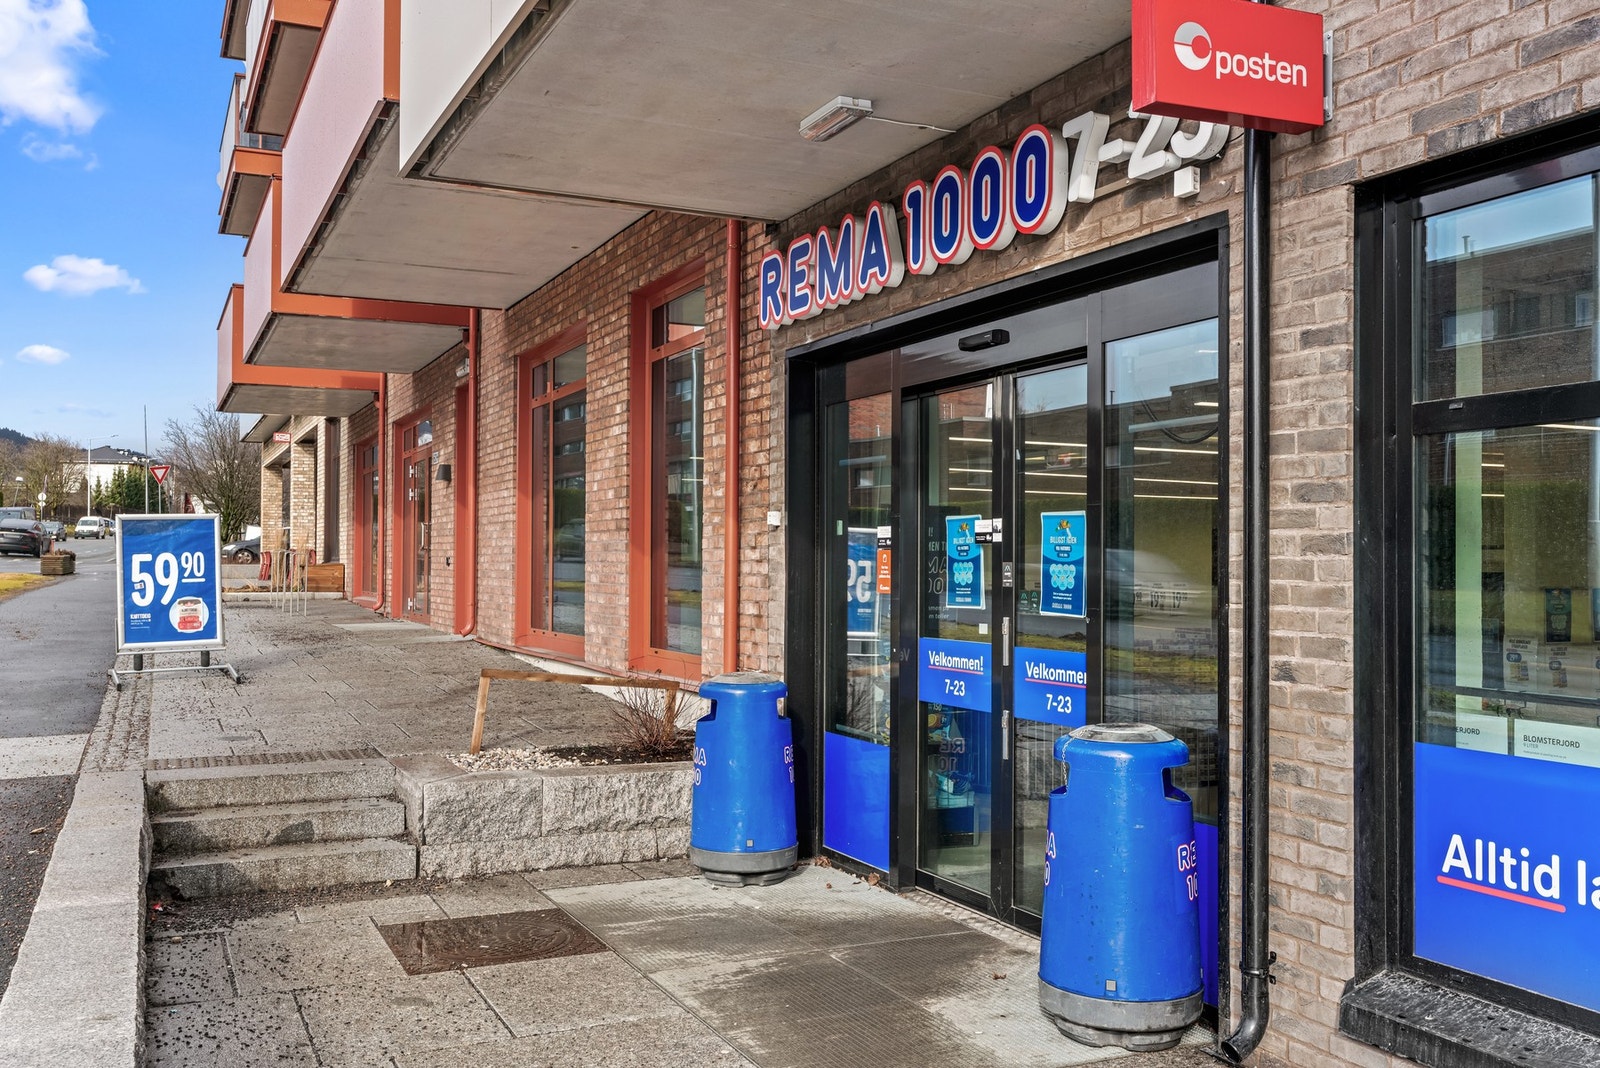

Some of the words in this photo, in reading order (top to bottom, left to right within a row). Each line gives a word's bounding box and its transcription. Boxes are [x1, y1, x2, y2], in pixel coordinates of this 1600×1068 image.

[1216, 51, 1307, 87] posten
[758, 200, 892, 330] REMA
[902, 124, 1055, 275] 1000
[131, 552, 179, 607] 59
[181, 551, 205, 577] 90
[928, 651, 984, 671] Velkommen!
[944, 679, 966, 697] 7-23
[1046, 694, 1072, 714] 7-23
[1523, 734, 1580, 749] BLOMSTERJORD
[1441, 833, 1560, 900] Alltid
